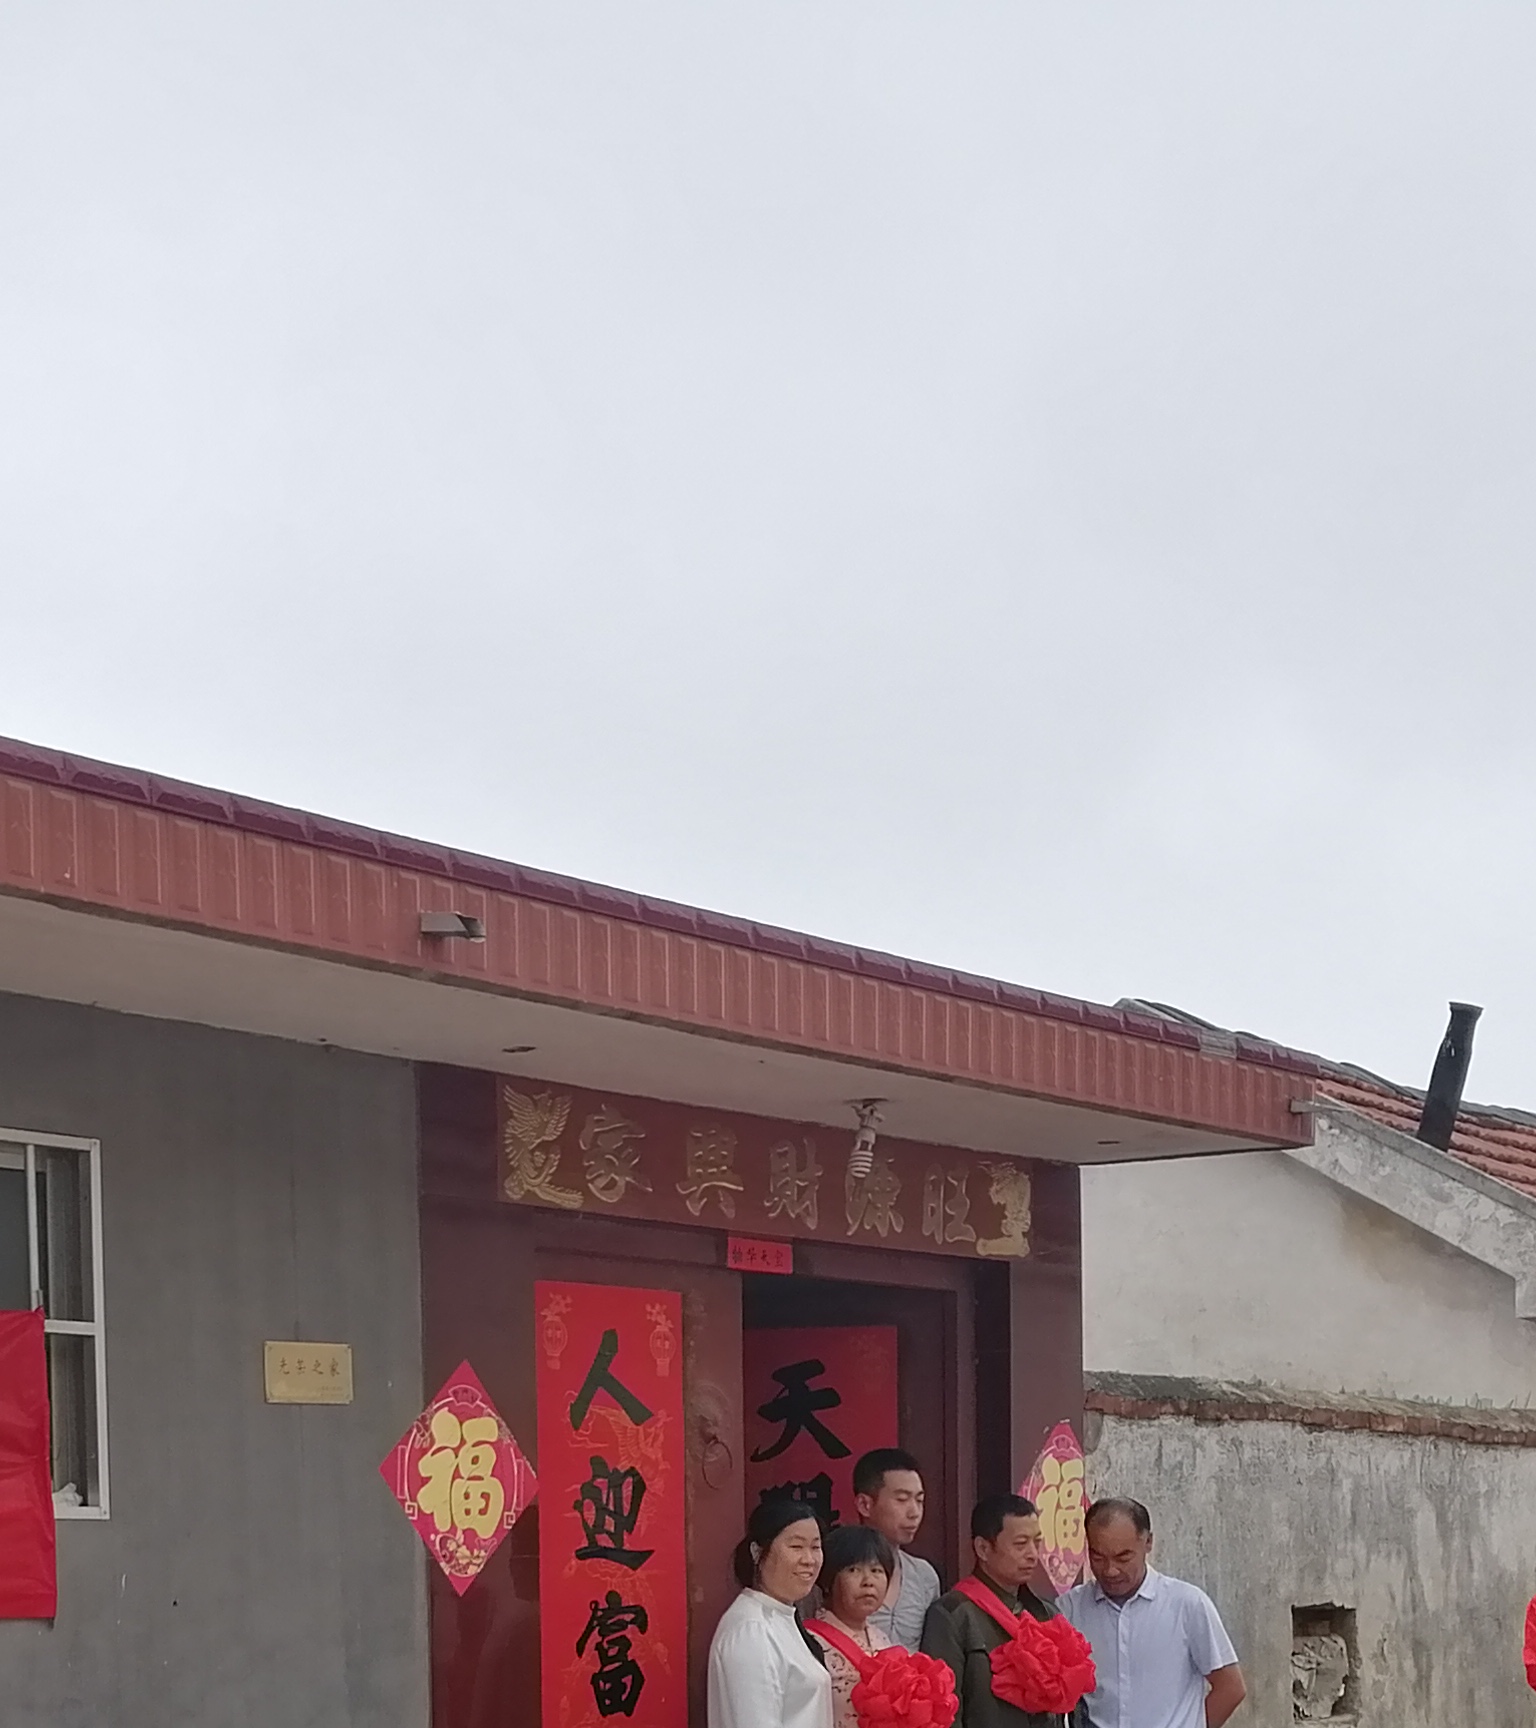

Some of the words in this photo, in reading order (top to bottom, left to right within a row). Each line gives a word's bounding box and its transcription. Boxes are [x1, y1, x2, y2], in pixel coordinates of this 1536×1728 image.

[279, 1357, 341, 1377] 光荣之家
[416, 1407, 505, 1540] 福
[1036, 1454, 1086, 1556] 福
